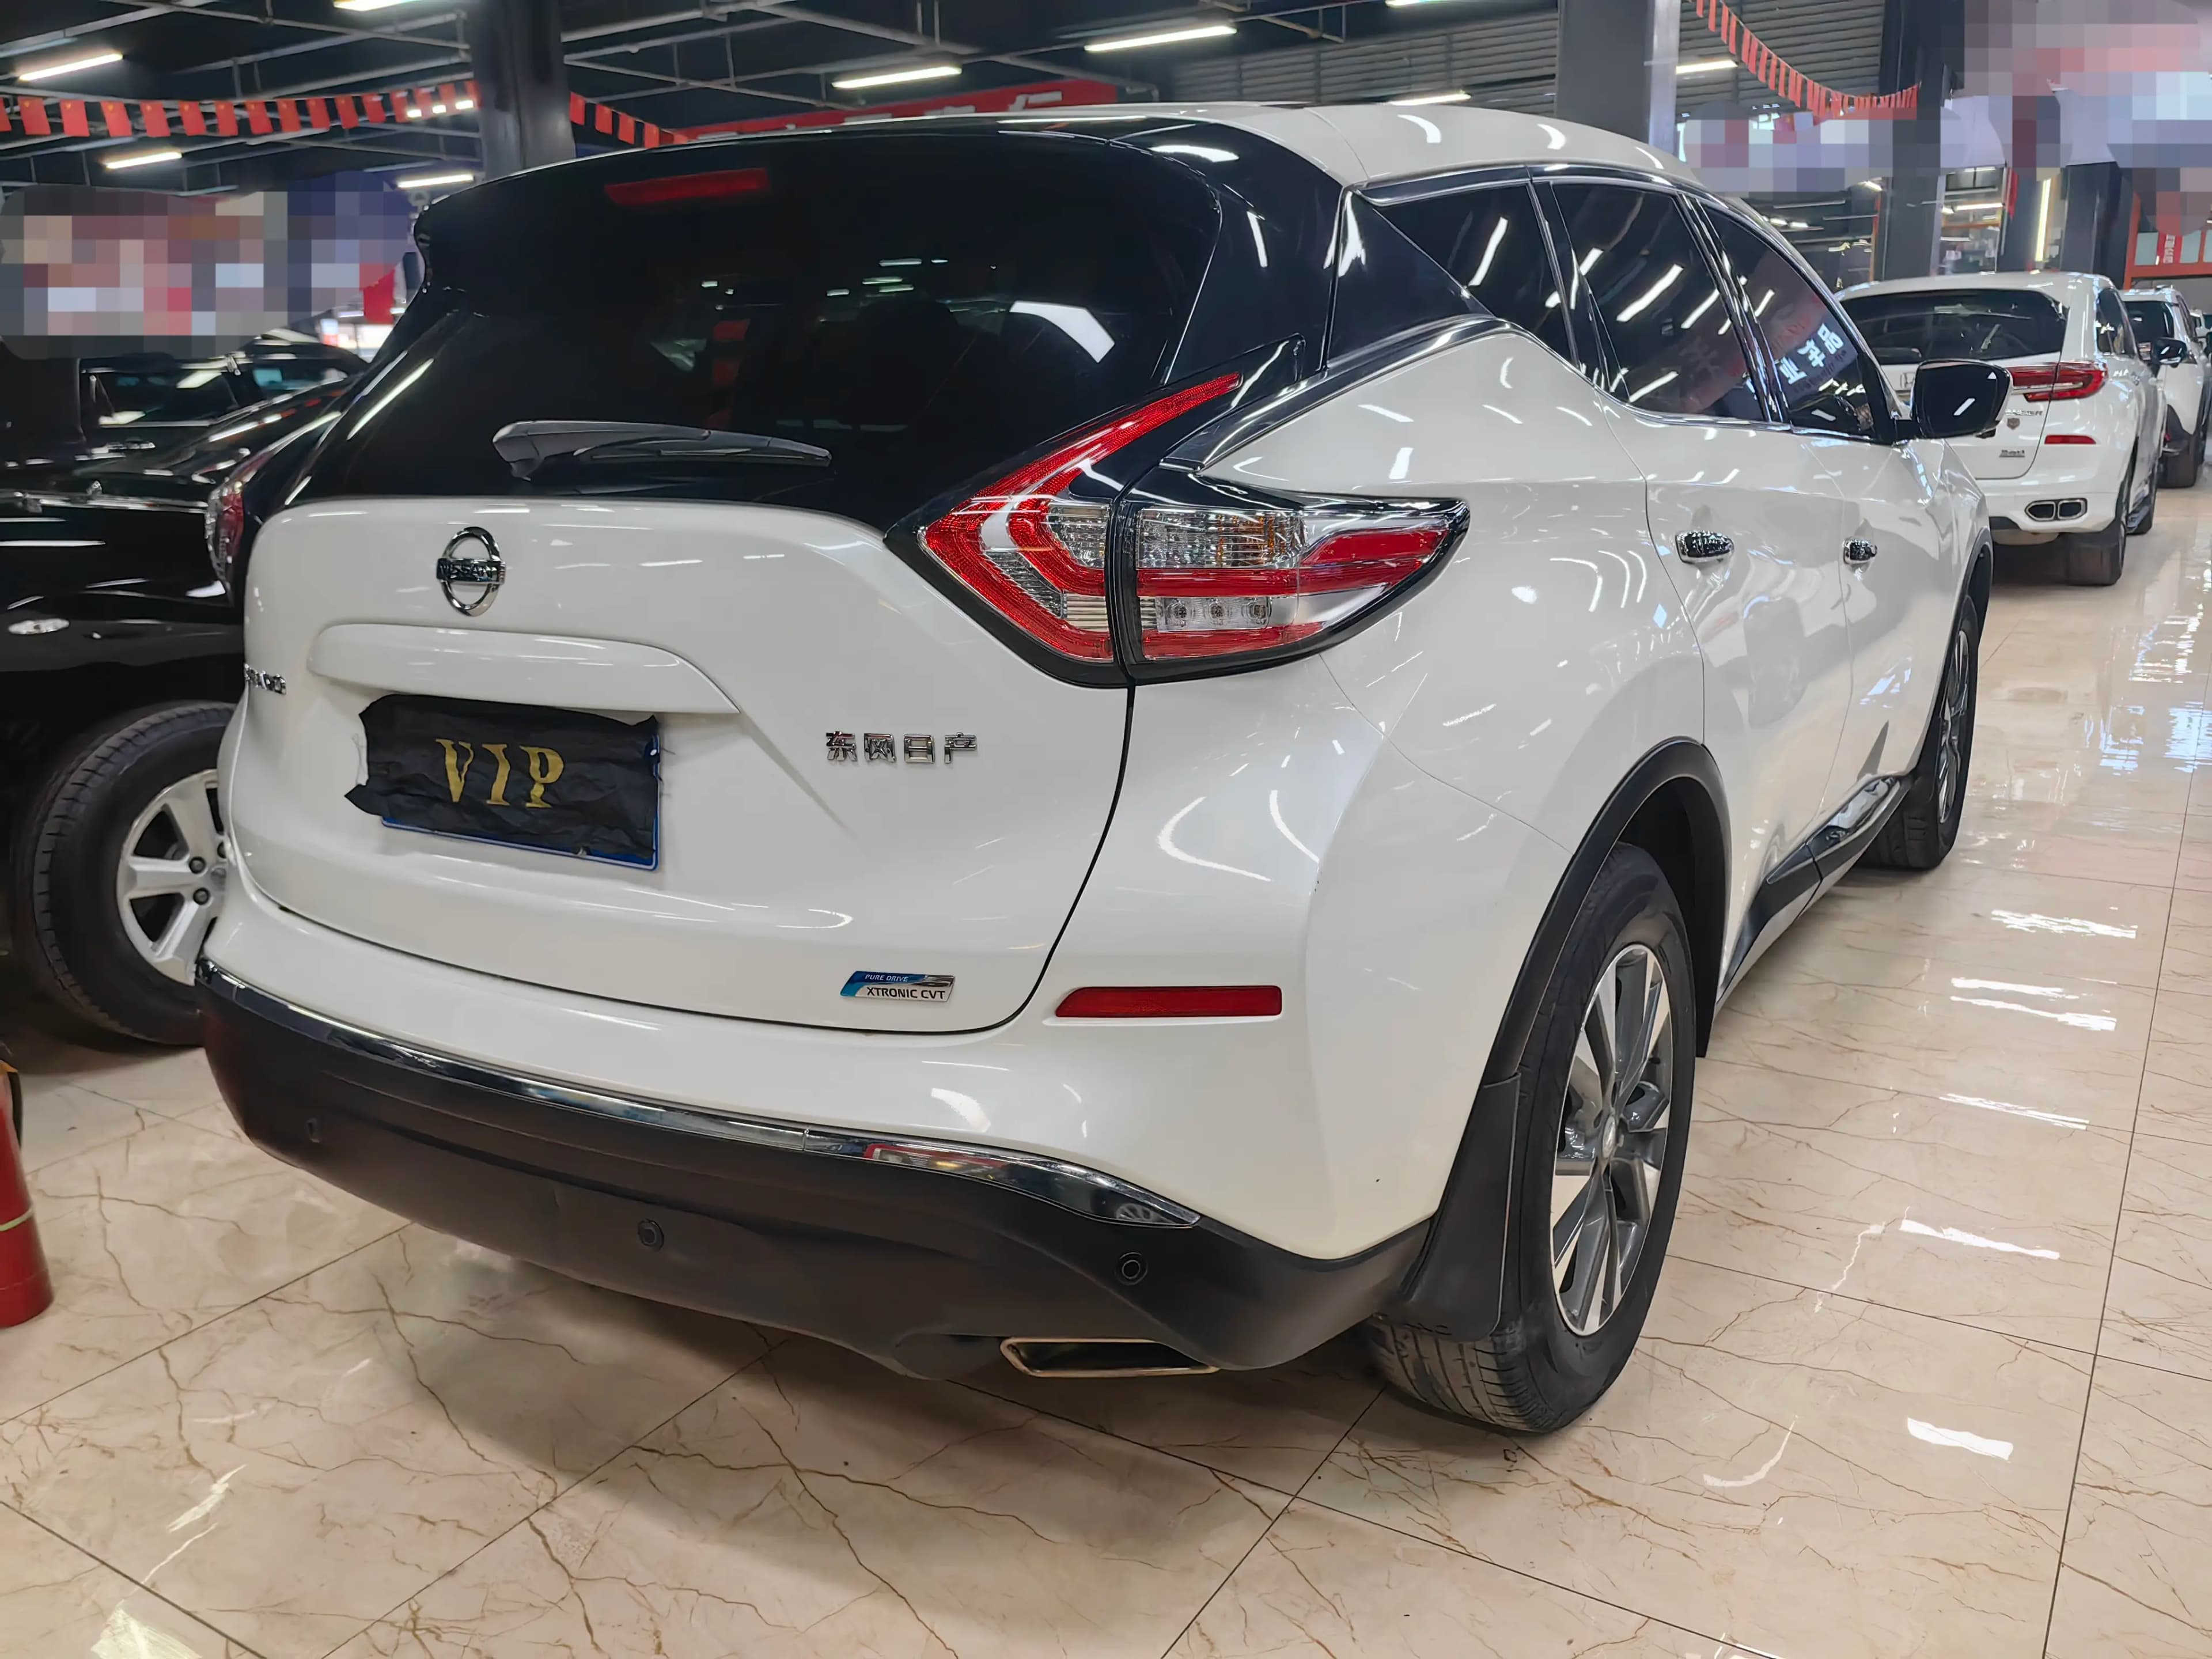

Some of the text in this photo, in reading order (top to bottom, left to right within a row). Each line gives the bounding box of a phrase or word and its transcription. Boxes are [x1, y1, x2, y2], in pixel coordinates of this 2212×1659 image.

[438, 563, 498, 578] NISSAN
[825, 730, 976, 763] 东风日产
[435, 738, 565, 808] VIP
[867, 987, 945, 999] XTRONIC CVT
